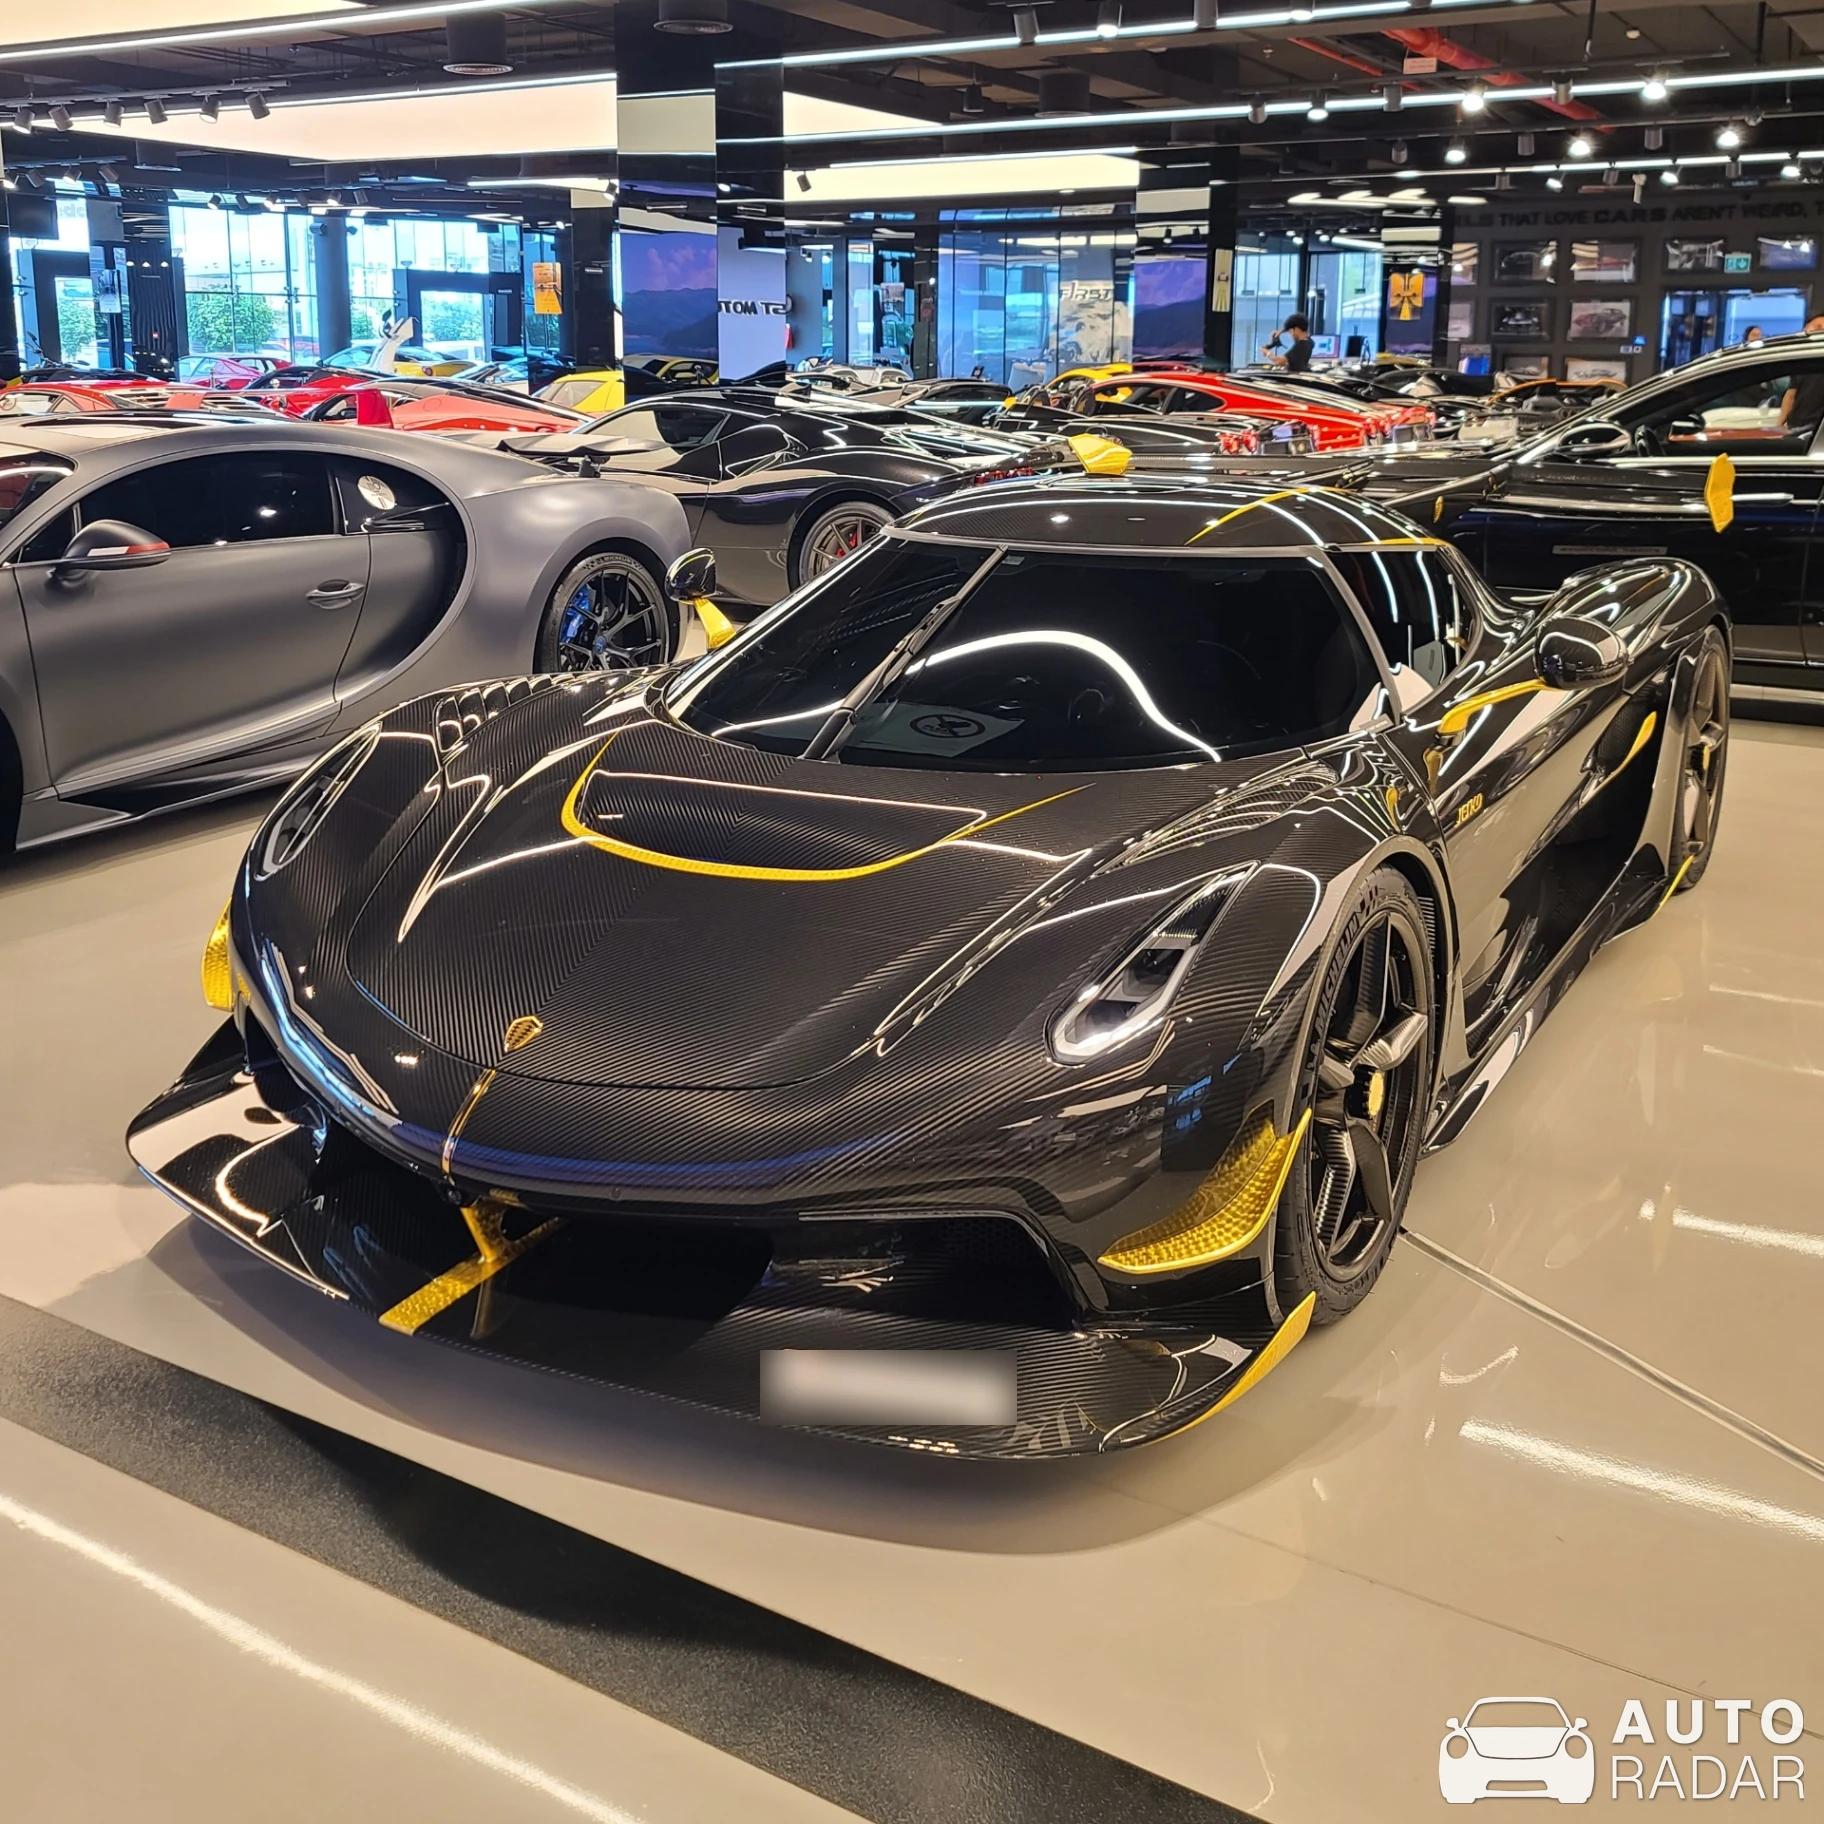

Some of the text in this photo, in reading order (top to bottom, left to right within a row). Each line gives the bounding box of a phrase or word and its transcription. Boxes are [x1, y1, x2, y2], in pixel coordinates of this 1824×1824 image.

[1498, 211, 1540, 227] THAT
[1544, 209, 1588, 225] LOVE
[1594, 207, 1667, 223] CARS
[1314, 911, 1361, 1036] MICHELIN
